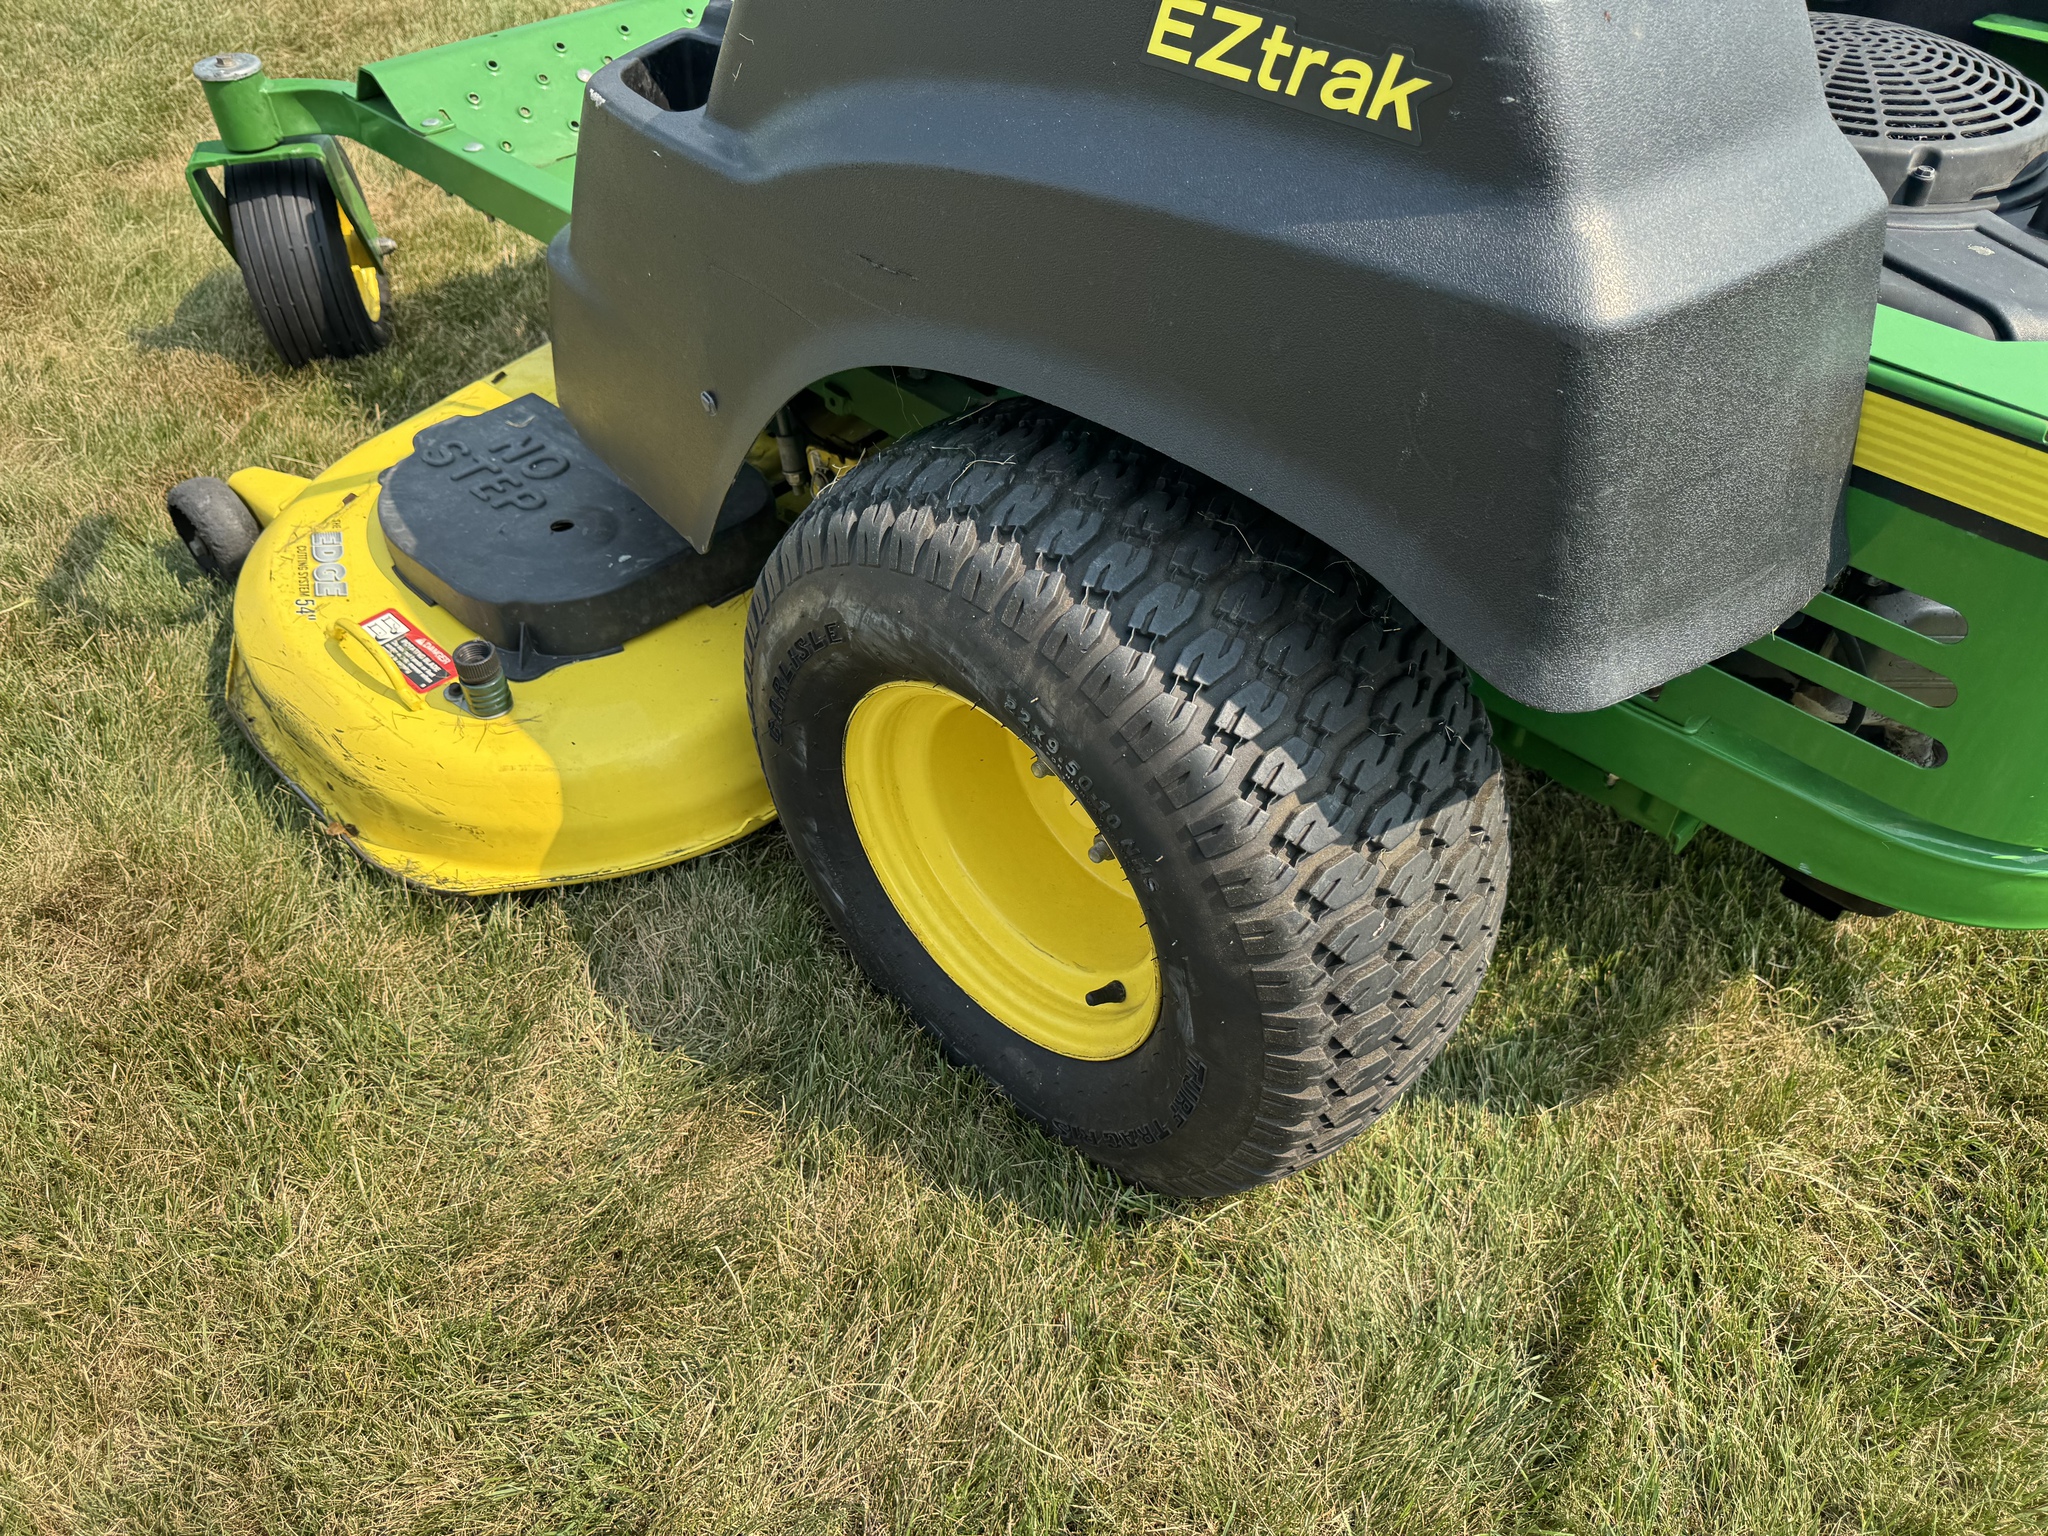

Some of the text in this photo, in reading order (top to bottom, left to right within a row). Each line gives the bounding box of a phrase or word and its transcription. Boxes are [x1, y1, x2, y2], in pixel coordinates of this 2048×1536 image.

[1147, 0, 1432, 131] EZtrak
[420, 440, 547, 510] STEP
[489, 435, 571, 480] NO
[295, 545, 317, 621] CUTTING SYSTEM 54"
[310, 531, 348, 597] EDGE
[421, 655, 442, 673] BLADE
[422, 640, 451, 665] DANGER
[768, 622, 843, 746] CARLISLE
[1168, 1056, 1208, 1129] TURF
[1102, 1117, 1173, 1150] TRAC
